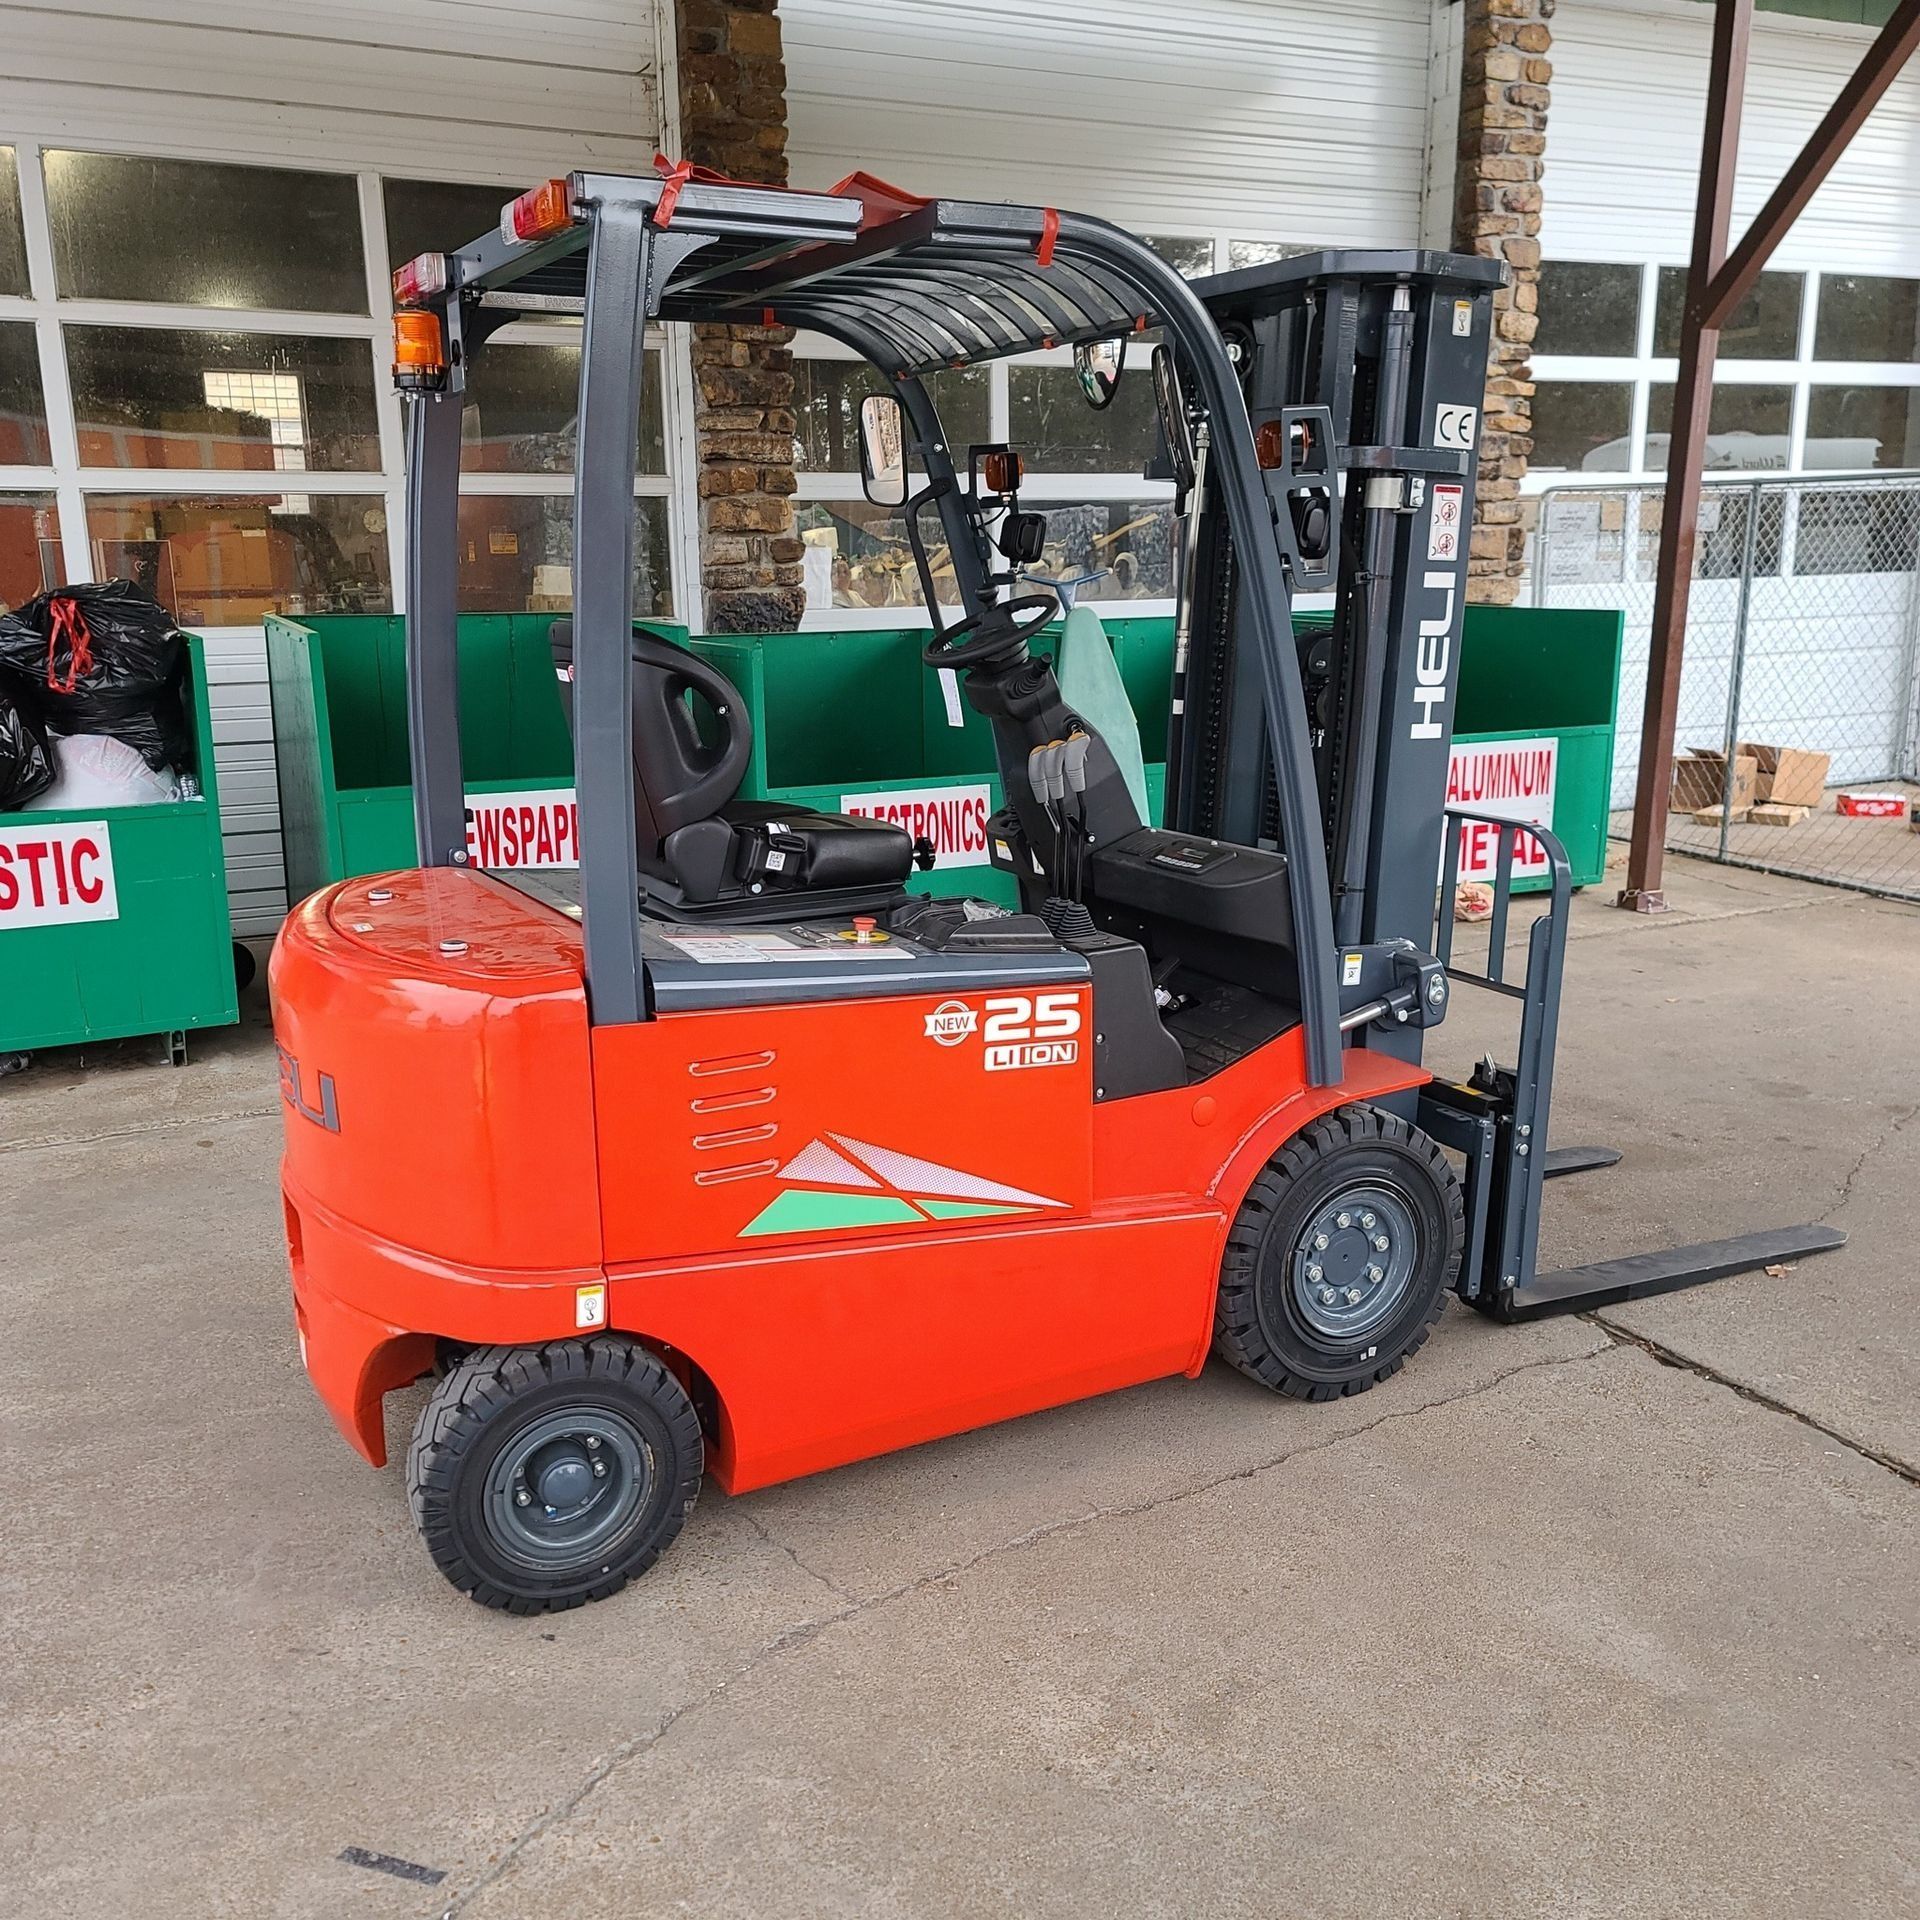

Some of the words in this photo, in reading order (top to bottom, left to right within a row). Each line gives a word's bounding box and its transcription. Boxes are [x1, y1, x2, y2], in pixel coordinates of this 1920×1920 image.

[1439, 411, 1473, 444] CE
[1410, 571, 1457, 740] HELI
[1446, 750, 1552, 803] ALUMINUM
[934, 1016, 970, 1032] NEW
[984, 993, 1081, 1043] 25
